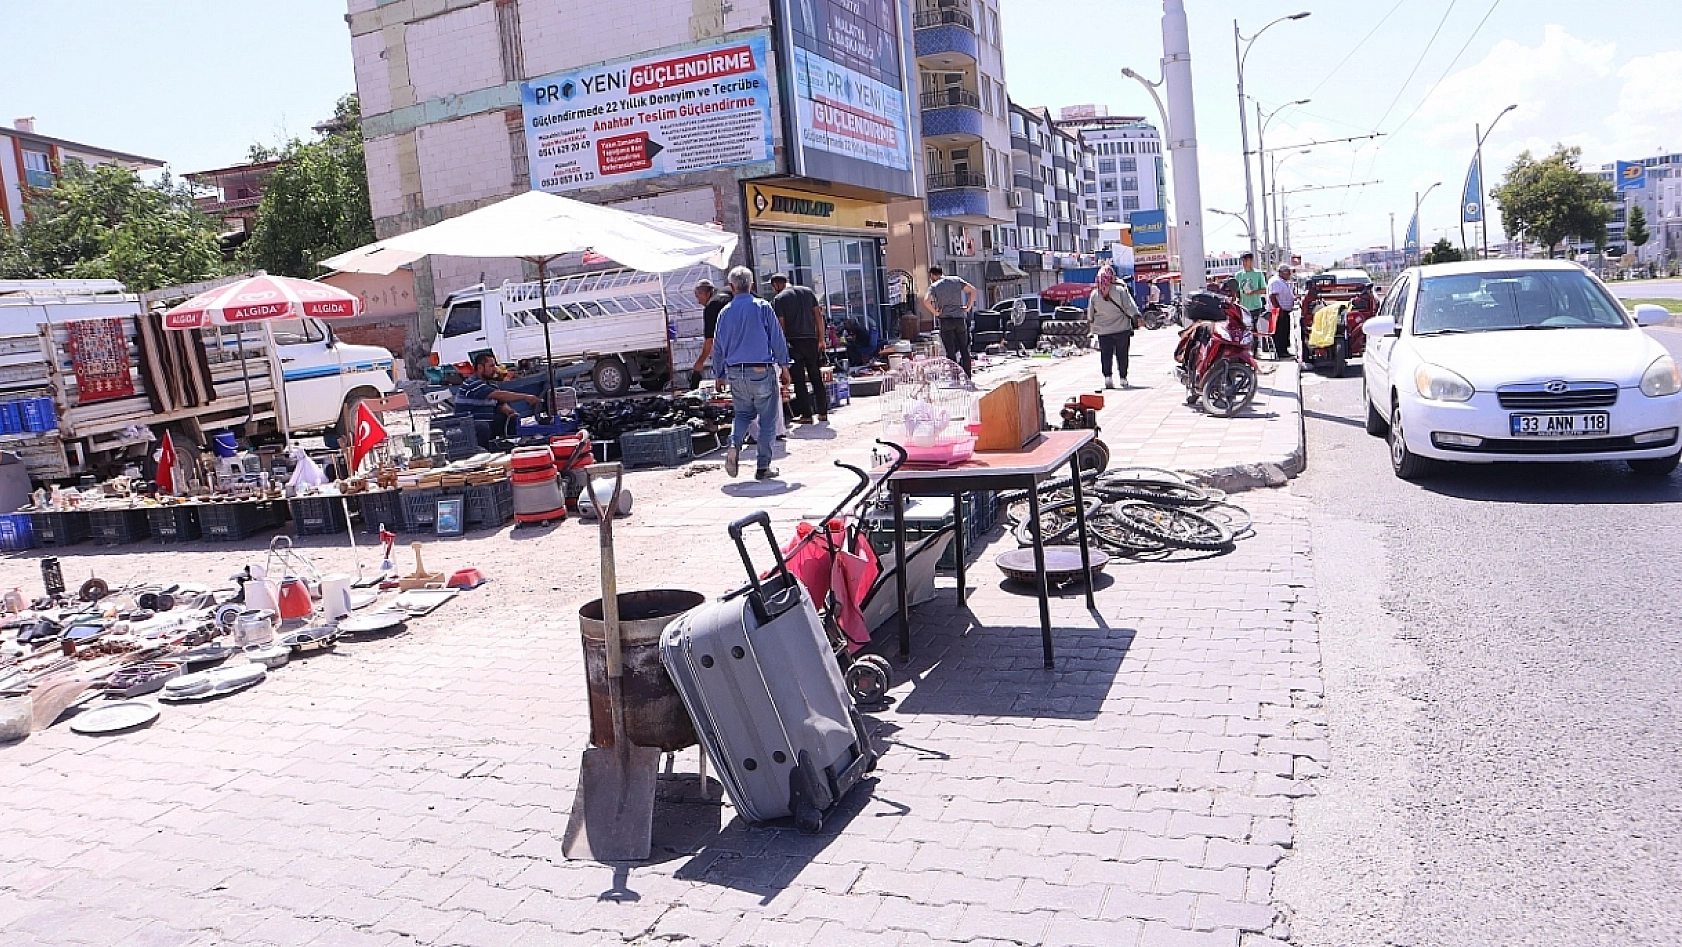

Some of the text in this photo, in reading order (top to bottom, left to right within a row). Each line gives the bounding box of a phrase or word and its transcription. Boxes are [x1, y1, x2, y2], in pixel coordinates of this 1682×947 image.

[632, 51, 751, 88] GÜÇLENDİRME
[532, 79, 759, 127] Güçlendirmede 22 Yıllık Deneyim ve Tecrübe
[593, 97, 755, 131] Anahtar Teslim Güçlendirme
[585, 172, 594, 181] 23
[770, 195, 835, 217] DUNLOP
[1522, 415, 1605, 431] 33 ANN 118
